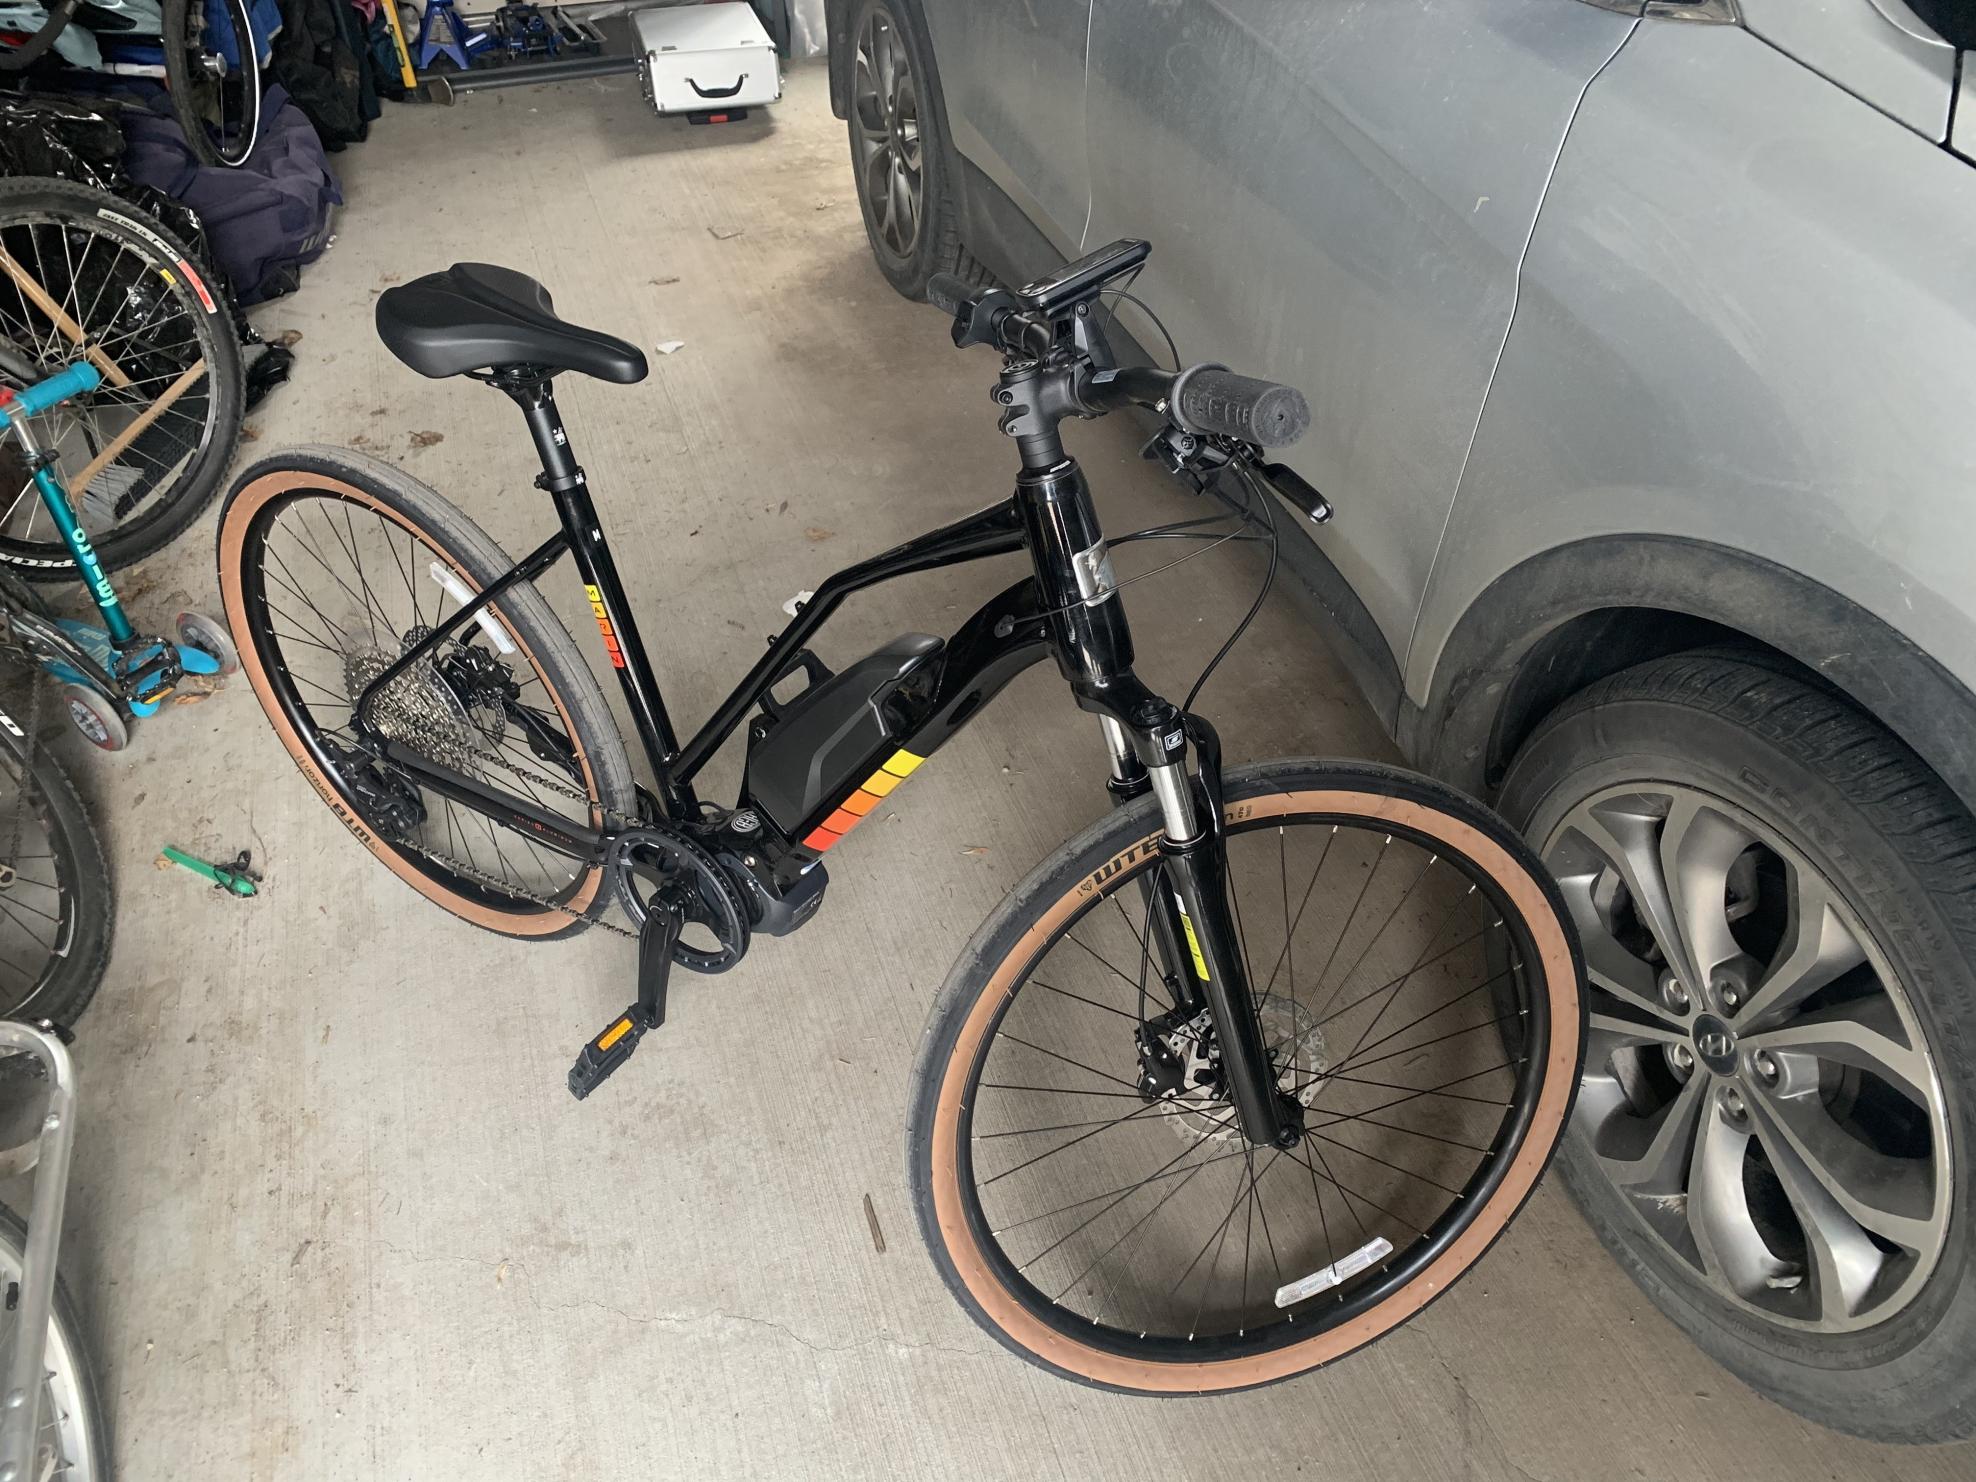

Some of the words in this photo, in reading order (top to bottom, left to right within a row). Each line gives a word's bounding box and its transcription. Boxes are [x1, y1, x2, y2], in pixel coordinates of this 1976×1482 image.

[0, 552, 77, 568] PECIA
[585, 586, 622, 667] MARIN
[332, 802, 372, 842] WTB
